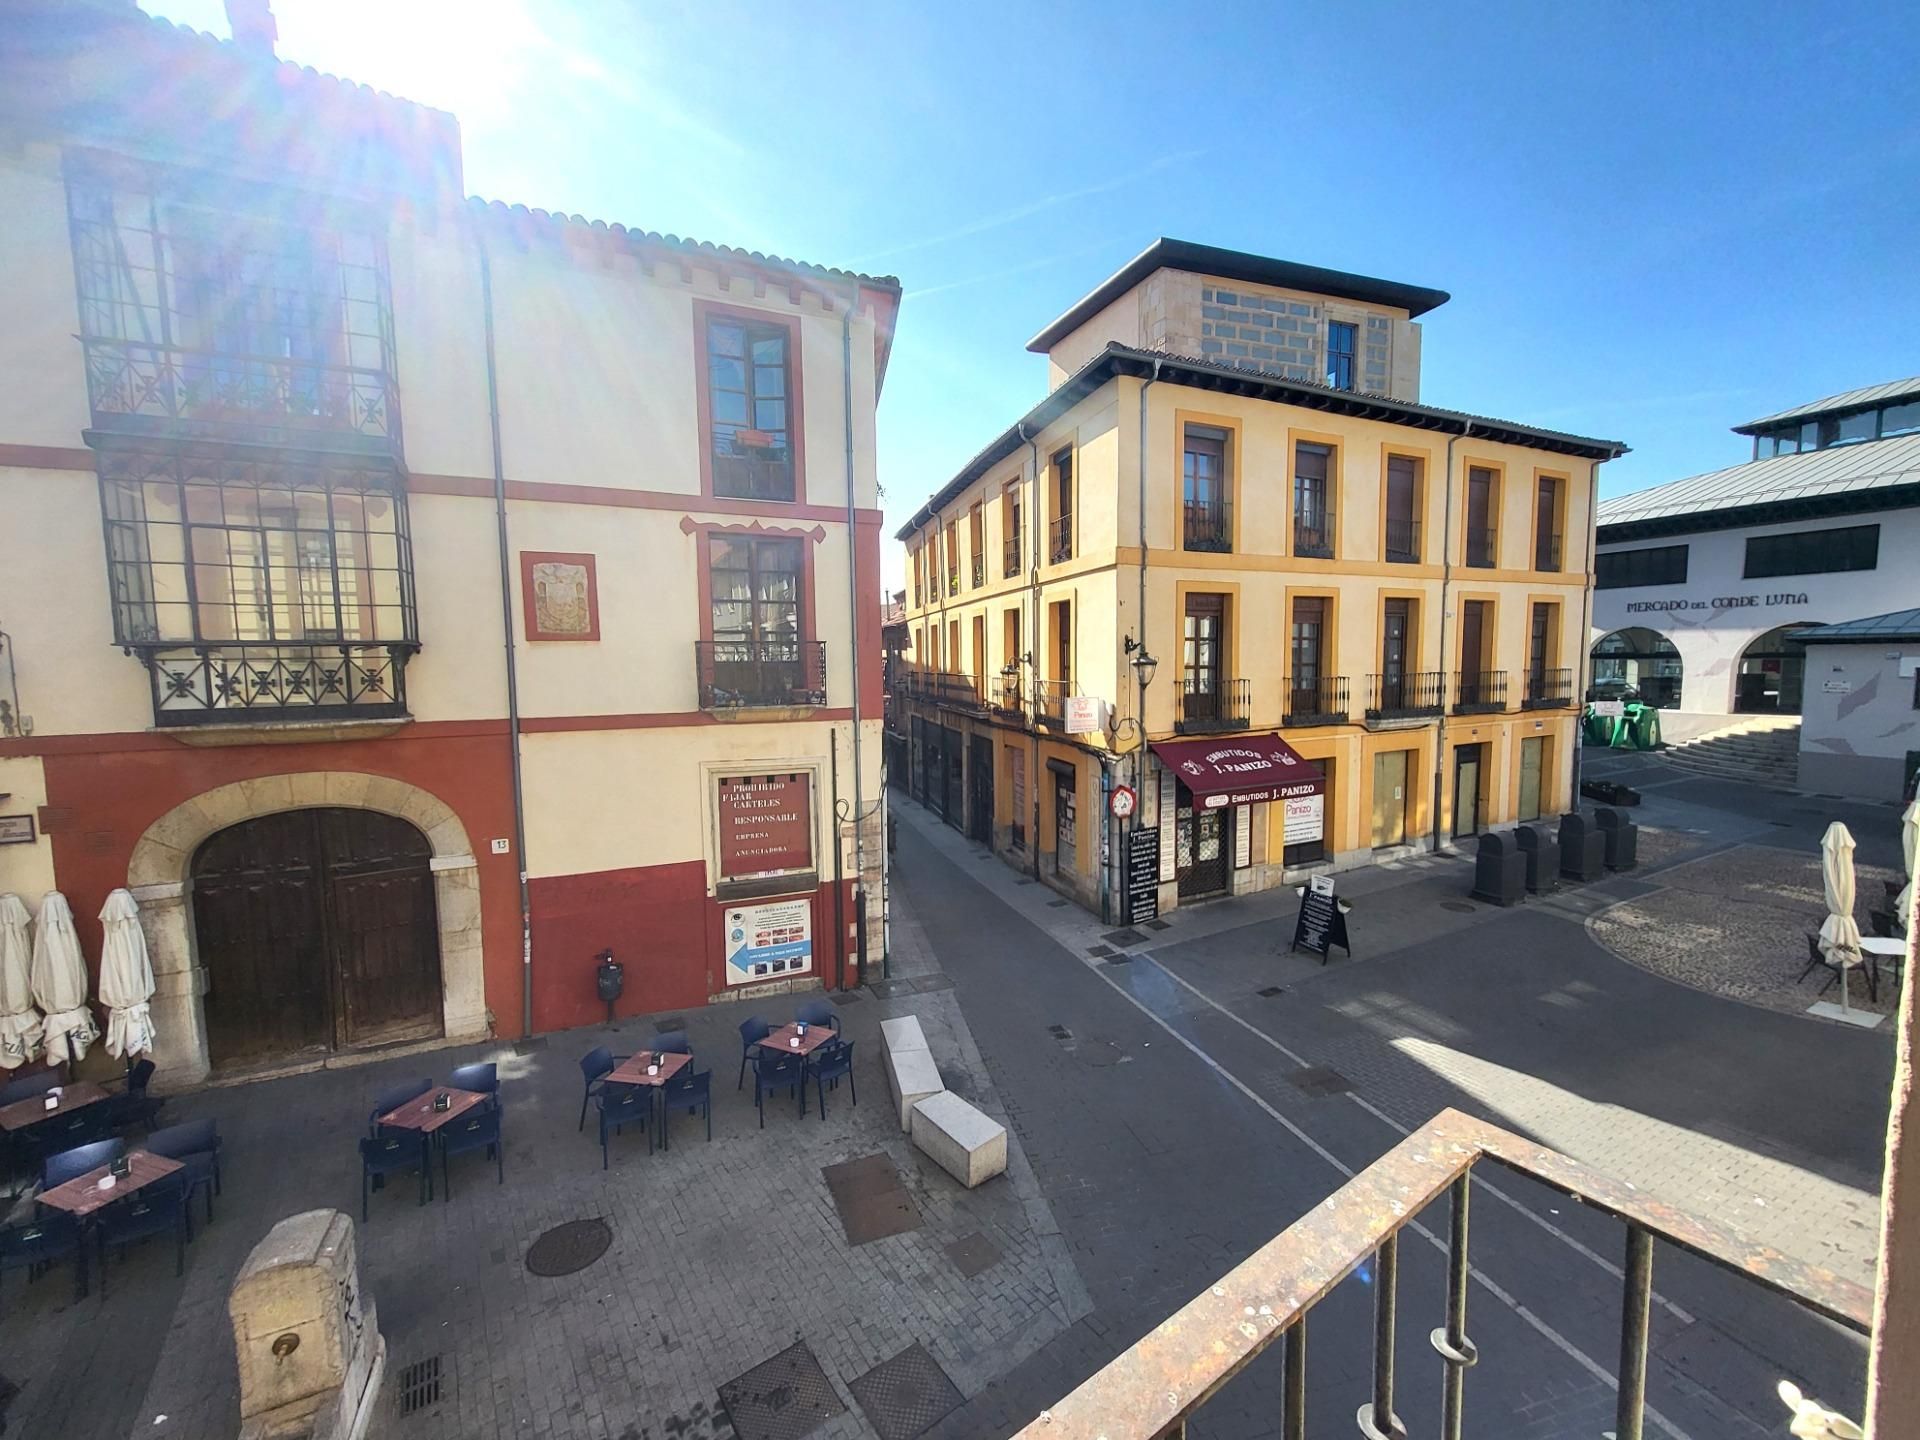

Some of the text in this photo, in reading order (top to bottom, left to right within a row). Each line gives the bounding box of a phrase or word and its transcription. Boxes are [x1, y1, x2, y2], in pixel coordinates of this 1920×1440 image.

[1627, 600, 1688, 613] MERCADO
[1711, 595, 1759, 609] CONDE
[1765, 593, 1808, 606] LUNA
[1205, 749, 1262, 763] EMBUTIDOS
[1213, 761, 1272, 774] J. PANIZO
[733, 783, 785, 793] PROHIBIDO
[722, 792, 752, 802] FIJAR
[1232, 792, 1269, 803] EMBUTIDOS
[1273, 789, 1280, 799] J.
[1281, 785, 1315, 797] PANIZO
[733, 799, 781, 809] CARTELES
[1286, 804, 1311, 815] Panizo
[734, 813, 798, 825] RESPONSABLE
[735, 832, 769, 840] EMPRESA
[497, 840, 507, 849] 13
[735, 846, 787, 857] ANUNCIADORA
